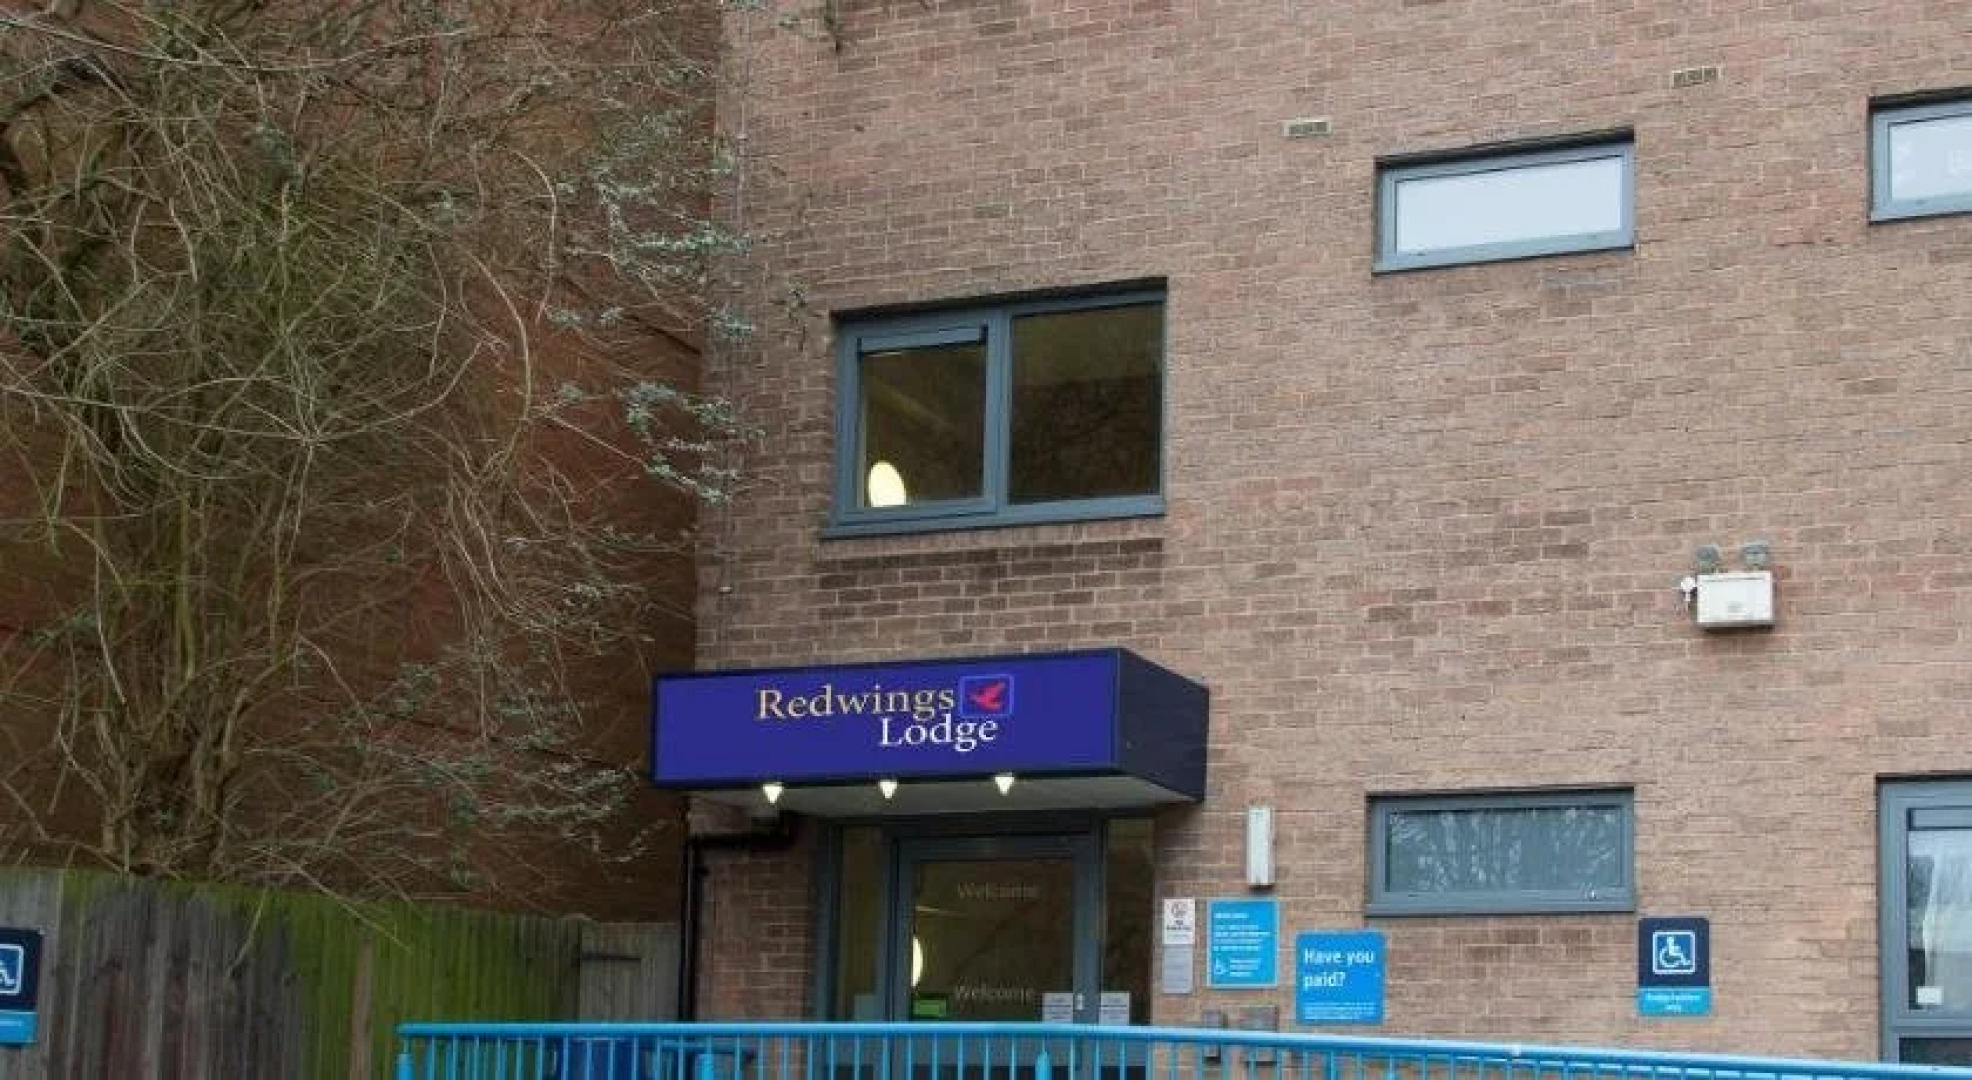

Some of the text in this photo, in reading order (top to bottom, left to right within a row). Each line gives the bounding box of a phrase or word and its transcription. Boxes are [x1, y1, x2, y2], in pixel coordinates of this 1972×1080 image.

[757, 683, 955, 721] Redwings
[880, 713, 998, 752] Lodge
[1304, 948, 1375, 968] Have you
[1303, 970, 1346, 992] paid?
